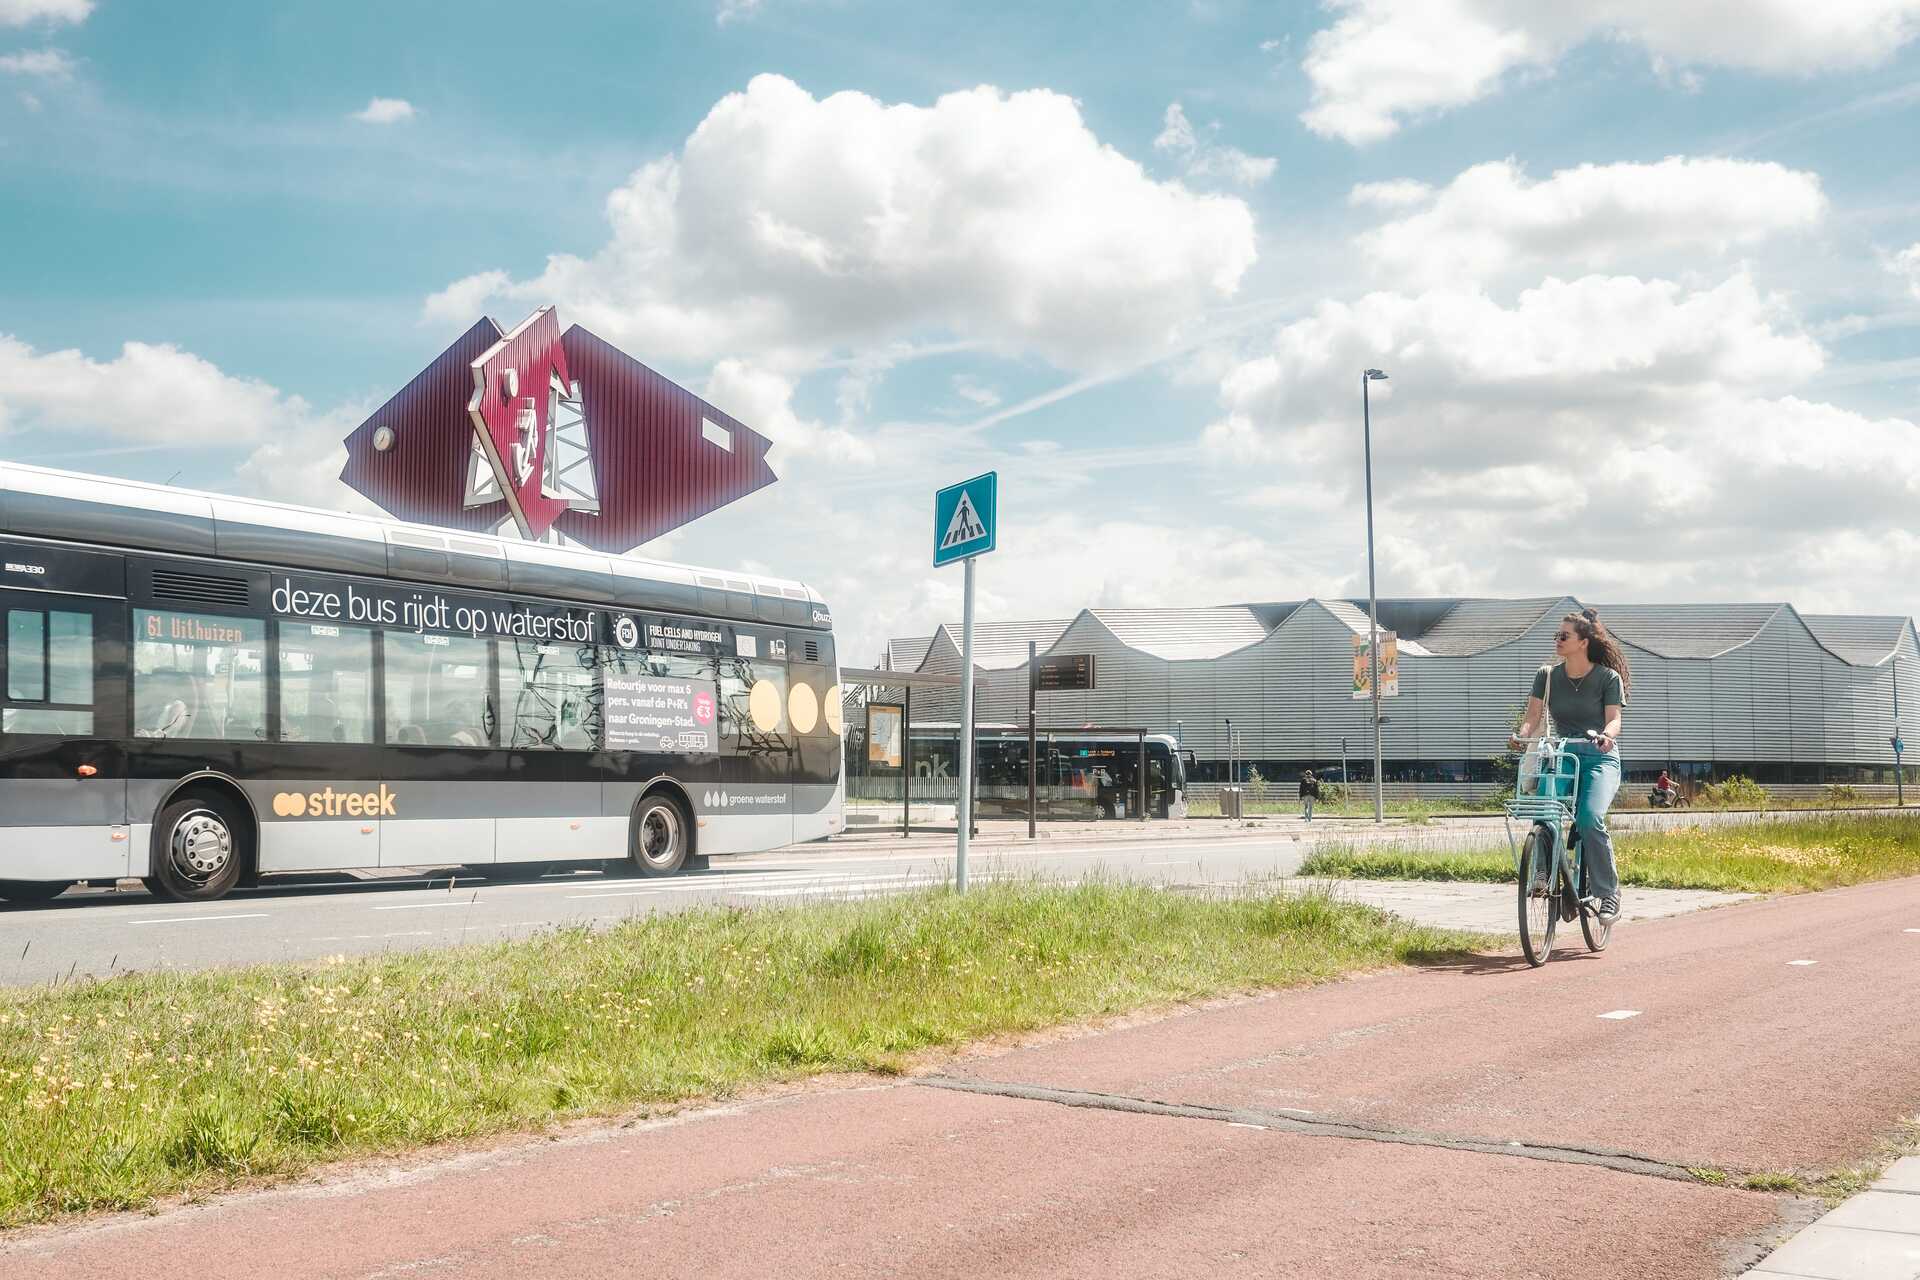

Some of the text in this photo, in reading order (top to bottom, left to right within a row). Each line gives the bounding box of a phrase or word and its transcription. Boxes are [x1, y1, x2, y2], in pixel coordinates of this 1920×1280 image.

[272, 578, 595, 641] deze bus rijdt op waterstof
[147, 616, 242, 642] 61 Uithuizen
[649, 625, 722, 643] FUEL CELLS AND HYDROGEN
[649, 637, 701, 652] JOINT UNDERTAKING
[607, 678, 646, 693] Retourtje
[648, 683, 666, 692] voor
[667, 685, 685, 694] max
[608, 697, 630, 708] pers.
[631, 697, 654, 708] vanaf
[655, 698, 666, 708] de
[608, 714, 628, 724] naar
[696, 705, 711, 719] €3
[308, 783, 397, 817] streek
[729, 792, 787, 807] groene waterstof
